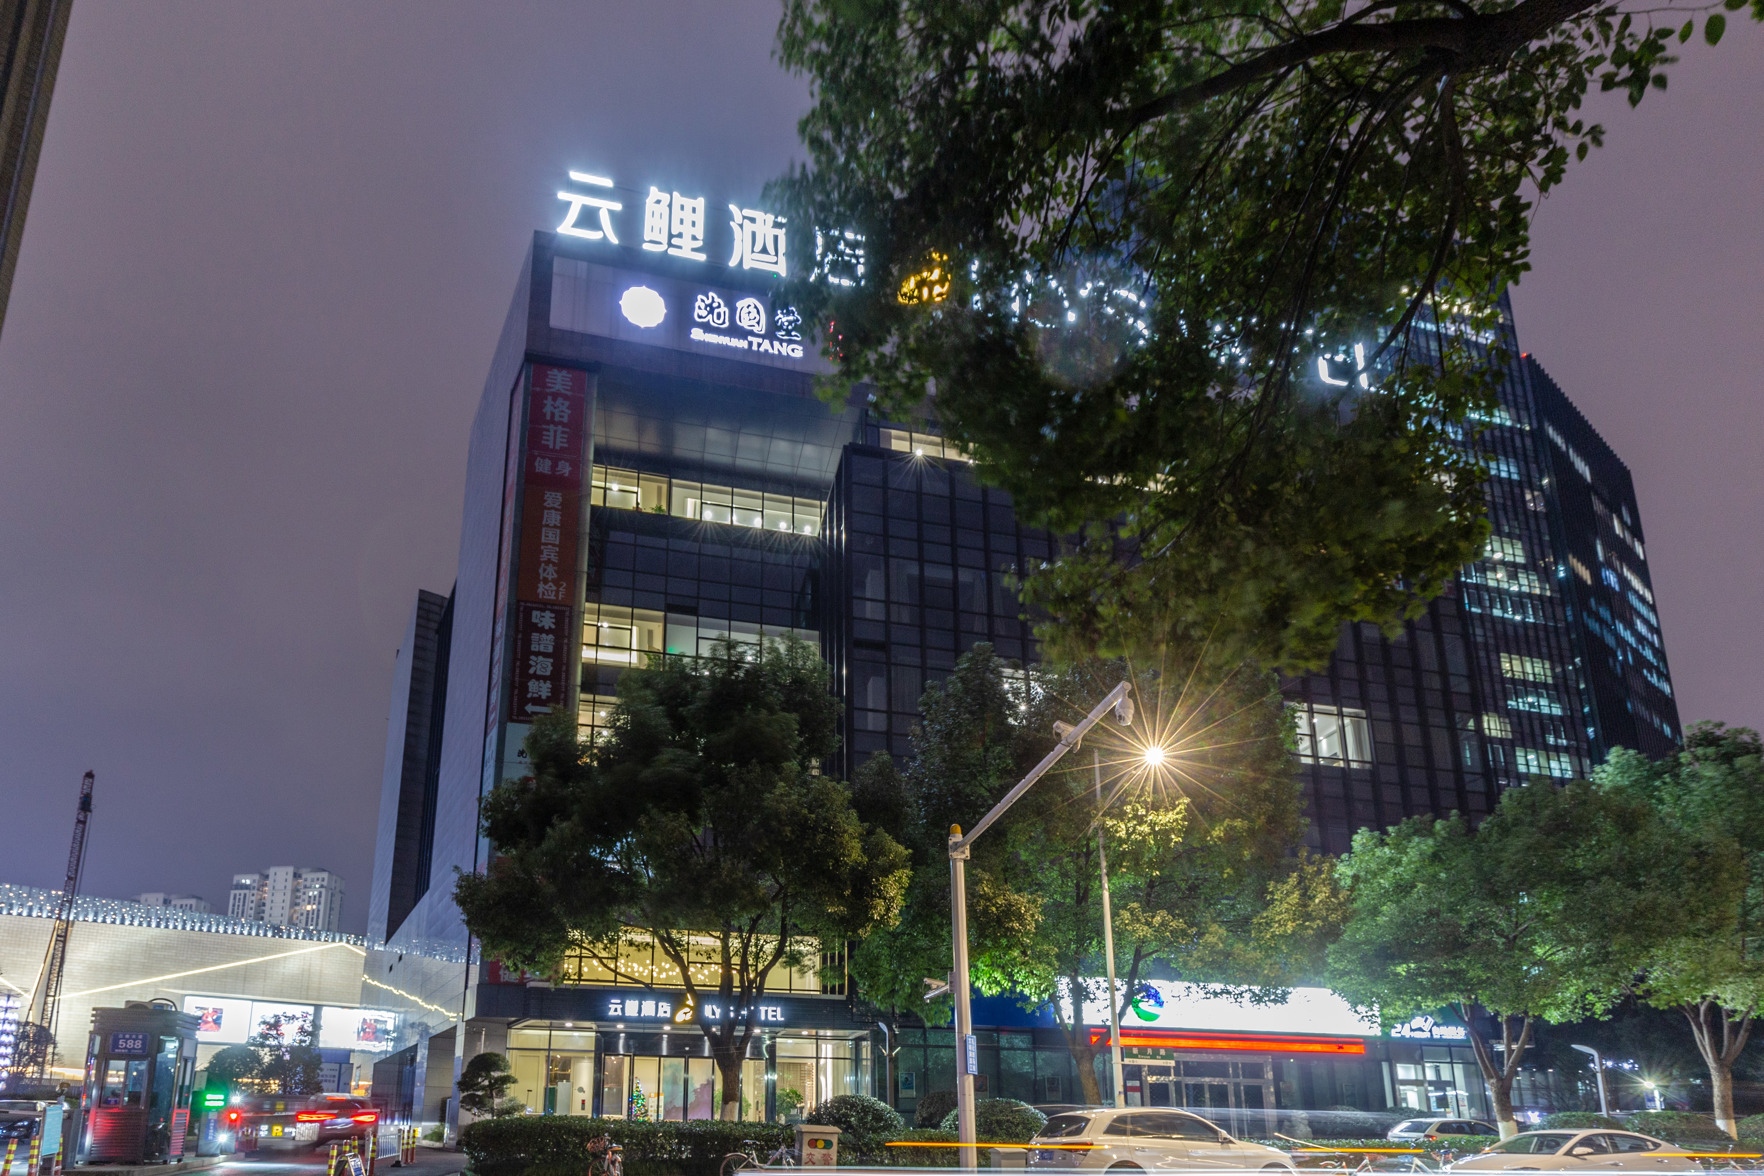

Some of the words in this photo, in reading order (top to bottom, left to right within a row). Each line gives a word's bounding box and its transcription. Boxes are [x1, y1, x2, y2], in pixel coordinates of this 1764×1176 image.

[556, 170, 866, 287] 云鲤酒店
[541, 368, 573, 450] 美格菲
[534, 456, 573, 477] 健身
[537, 490, 563, 600] 爱康国宾体检
[118, 1039, 142, 1049] 588
[804, 1151, 833, 1166] 交警
